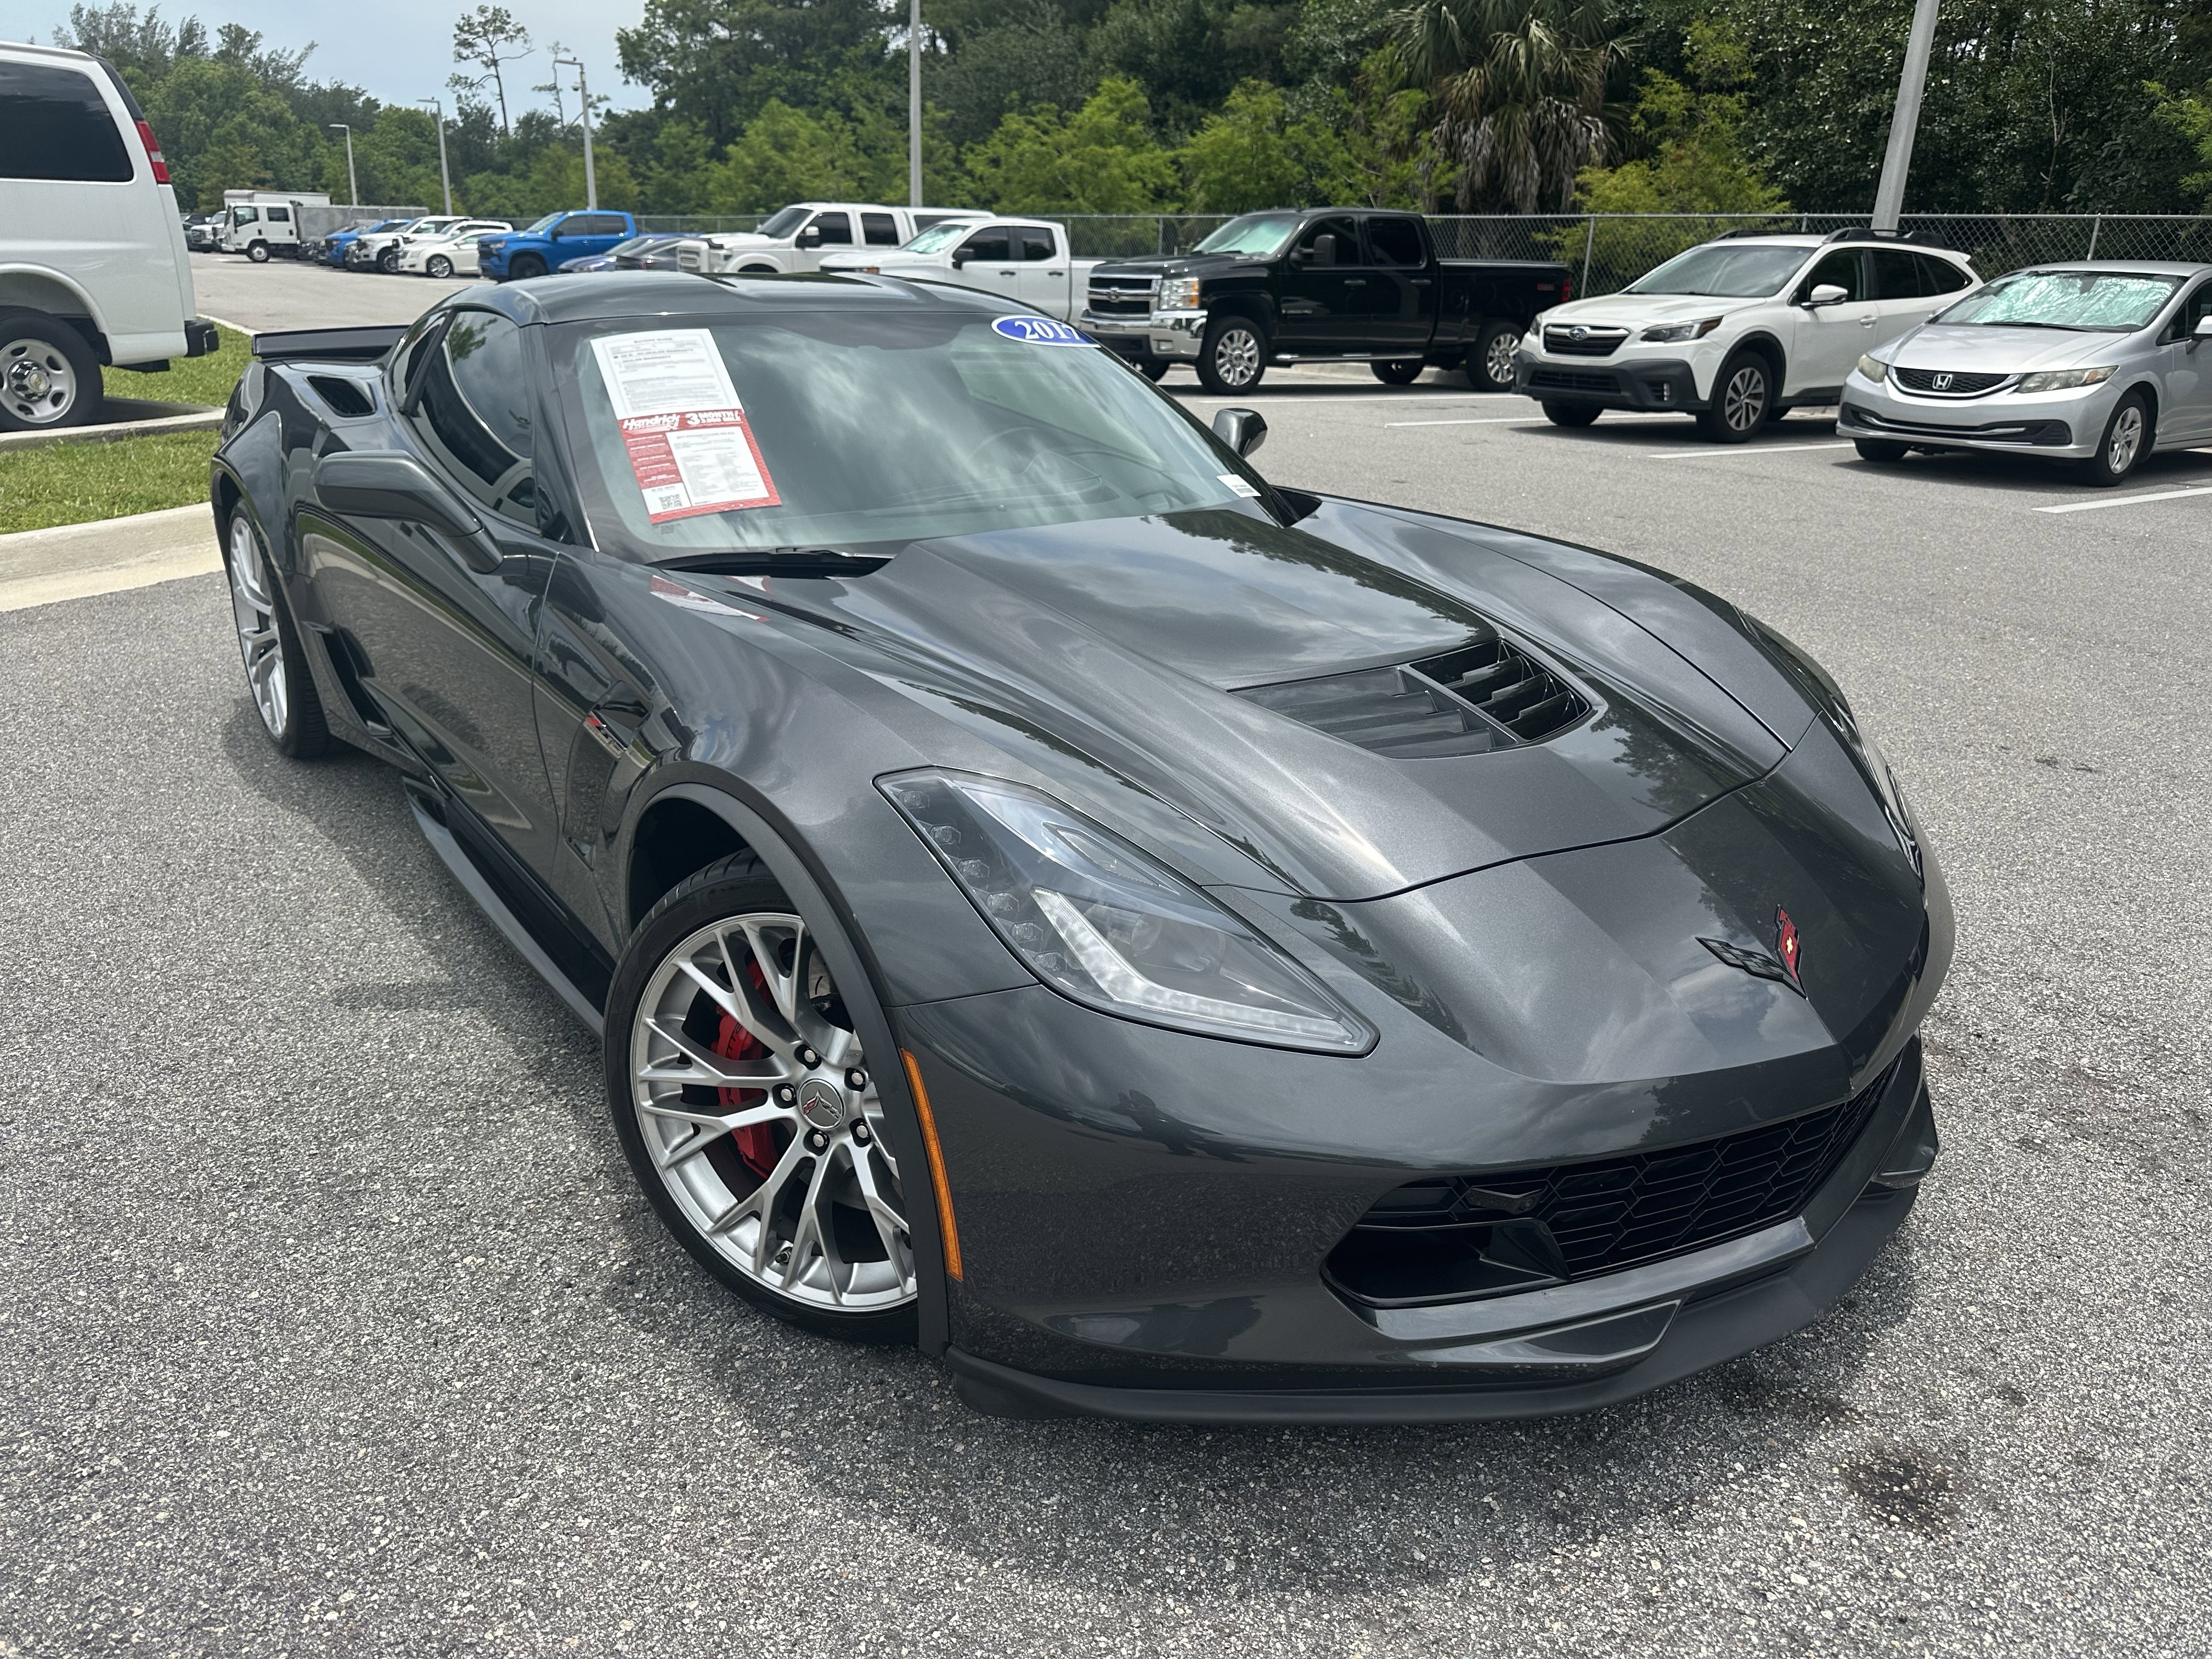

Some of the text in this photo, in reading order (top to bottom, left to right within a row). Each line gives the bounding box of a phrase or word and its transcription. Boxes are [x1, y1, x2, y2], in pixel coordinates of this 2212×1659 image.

[1014, 321, 1080, 341] 2017
[623, 414, 681, 430] Hendrick
[685, 413, 701, 425] 3
